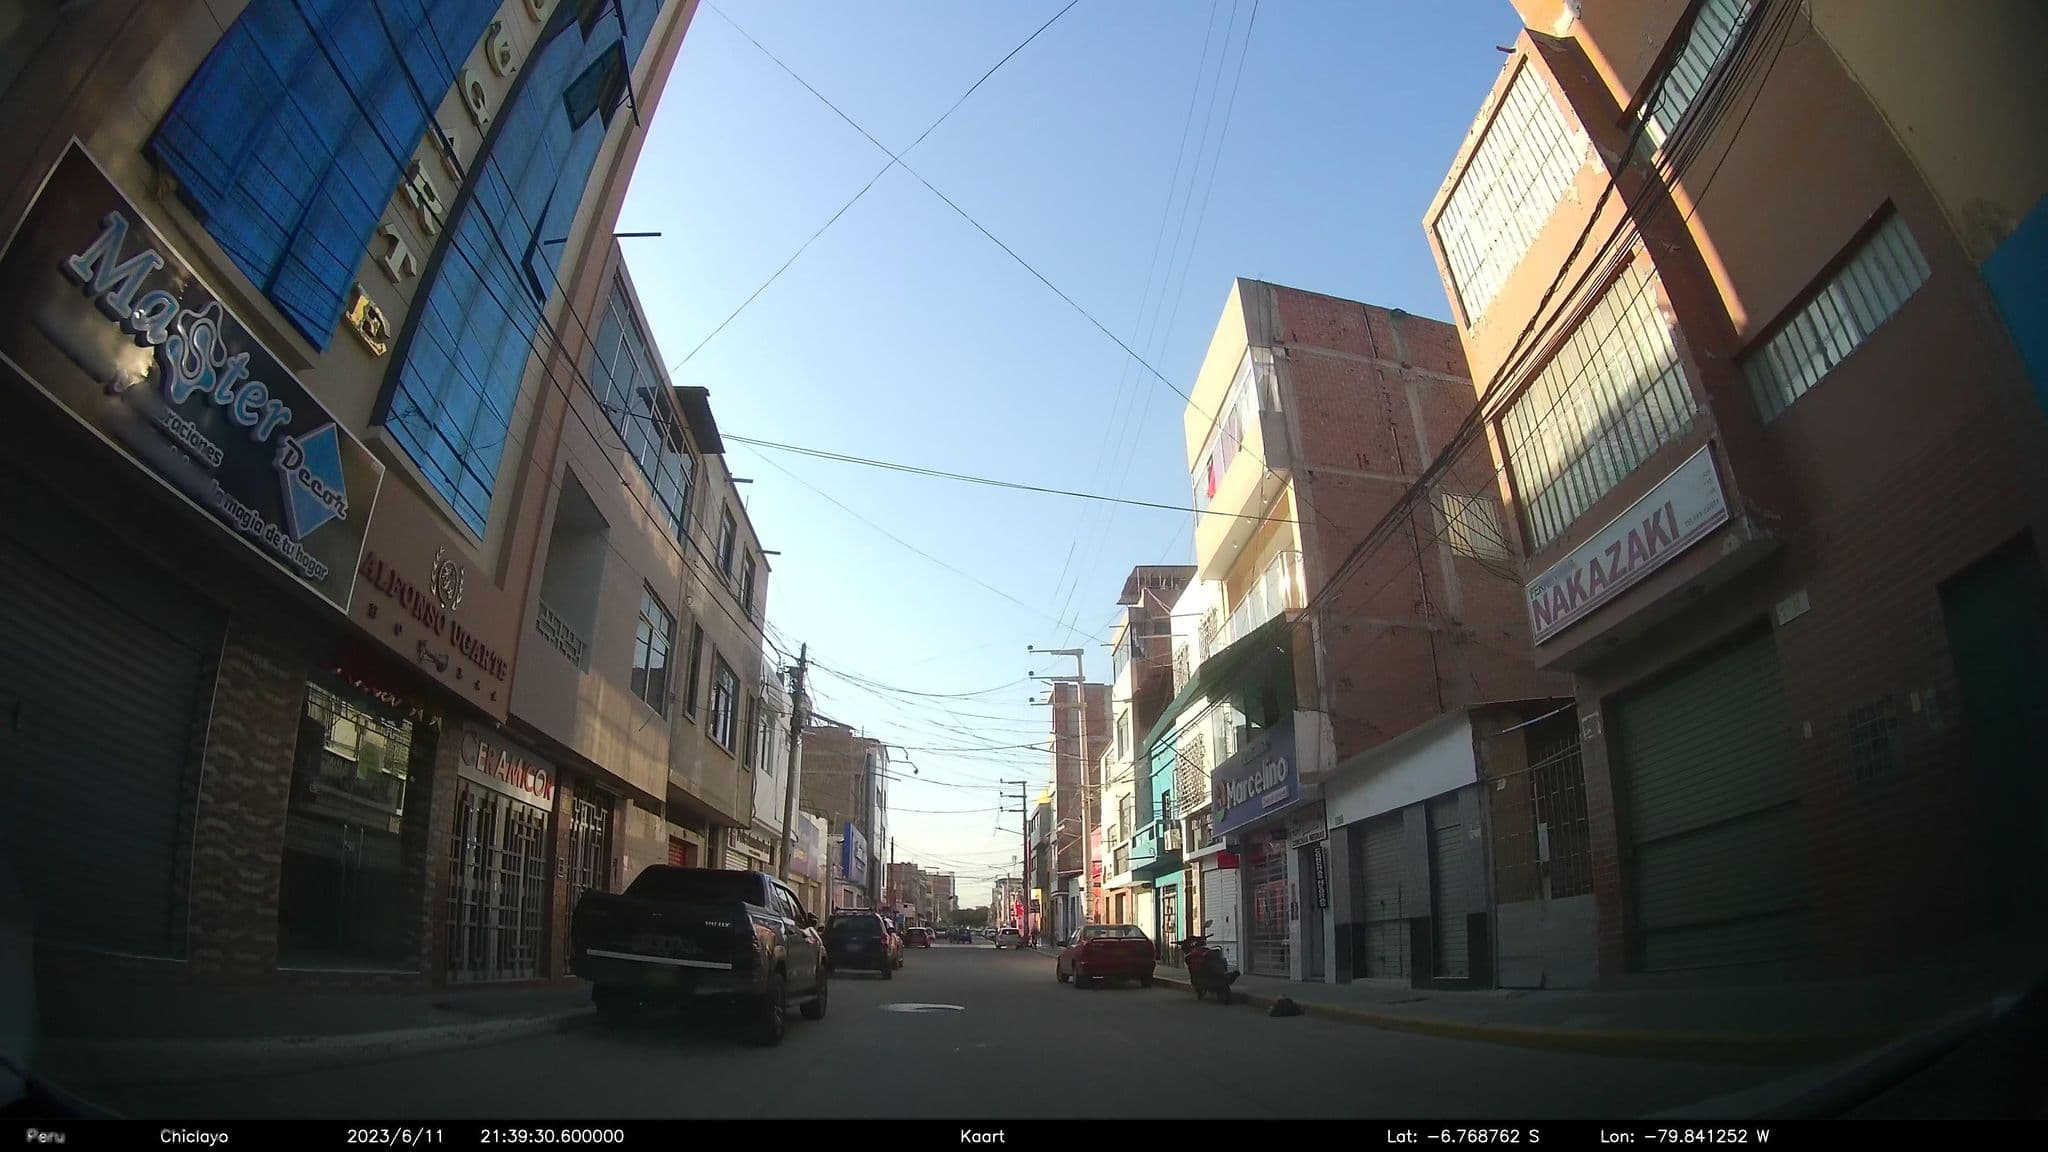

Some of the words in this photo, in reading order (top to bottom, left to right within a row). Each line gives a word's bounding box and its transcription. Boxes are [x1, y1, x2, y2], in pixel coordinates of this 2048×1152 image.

[345, 20, 524, 357] UGARTE
[232, 498, 274, 535] magia
[274, 524, 301, 550] de
[1530, 500, 1681, 631] NAKAZAKI
[1226, 757, 1288, 810] Marcelino
